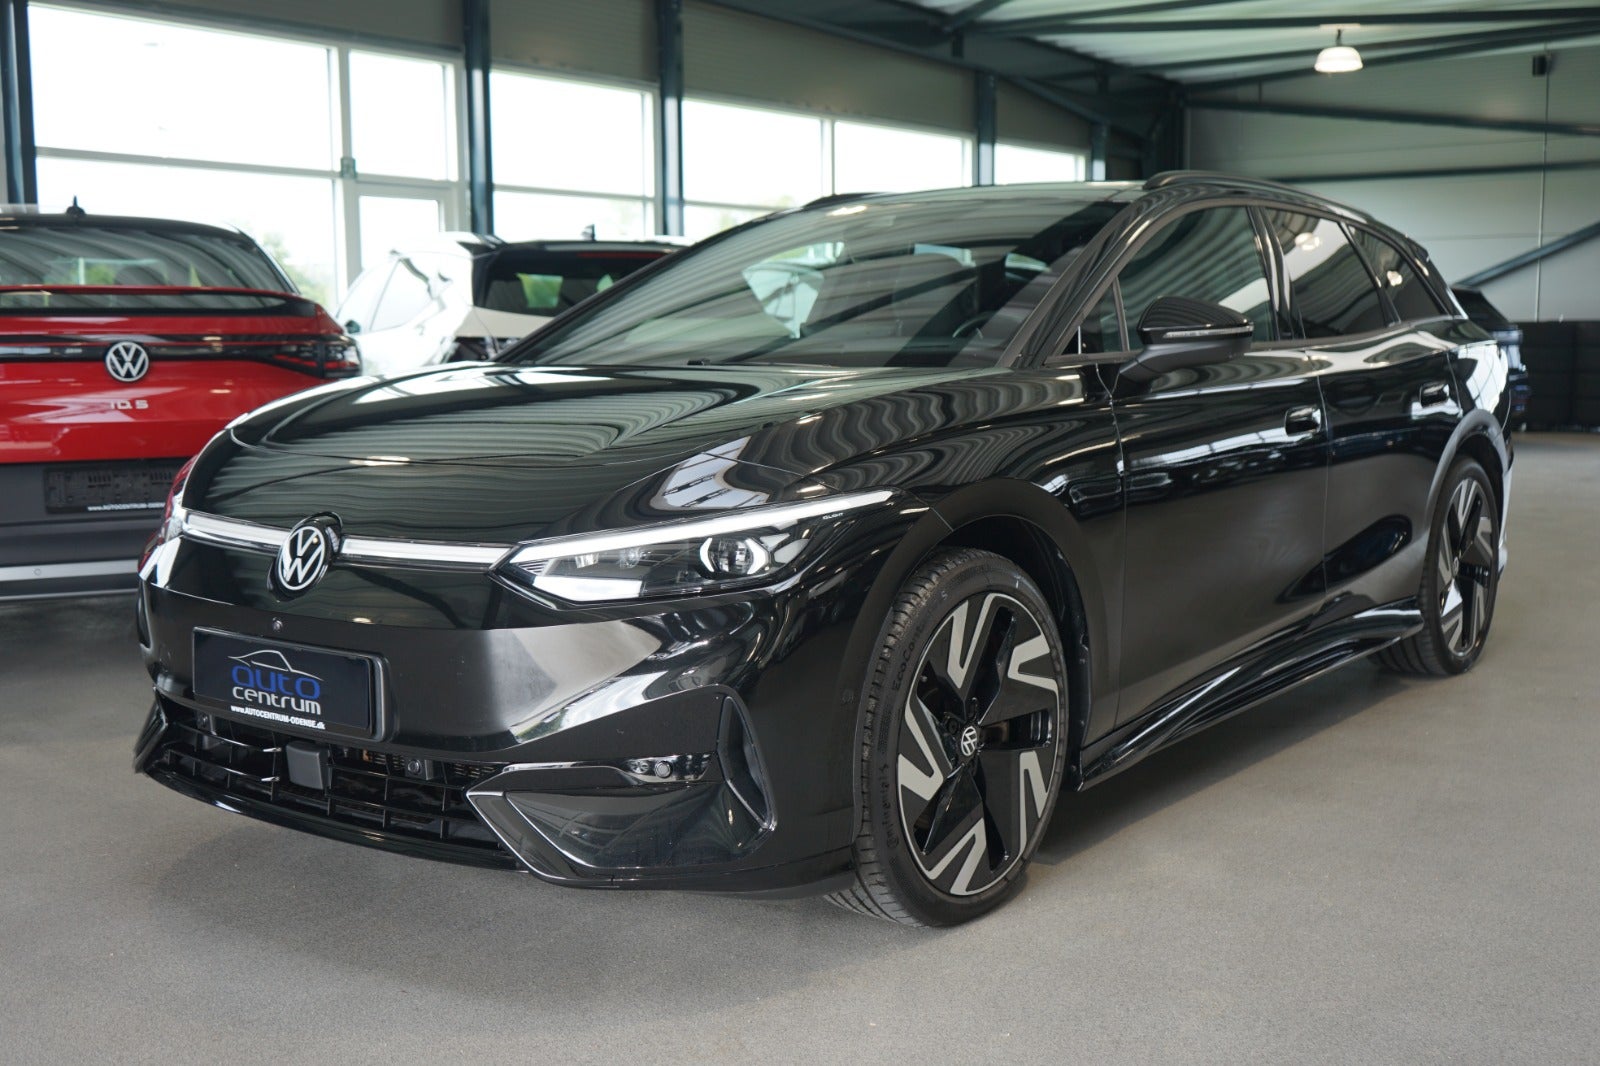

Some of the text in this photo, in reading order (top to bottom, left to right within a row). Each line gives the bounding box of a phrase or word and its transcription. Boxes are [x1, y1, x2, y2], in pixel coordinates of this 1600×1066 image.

[106, 341, 149, 382] VW
[277, 526, 326, 591] VW
[231, 665, 321, 700] auto
[232, 686, 321, 715] centrum
